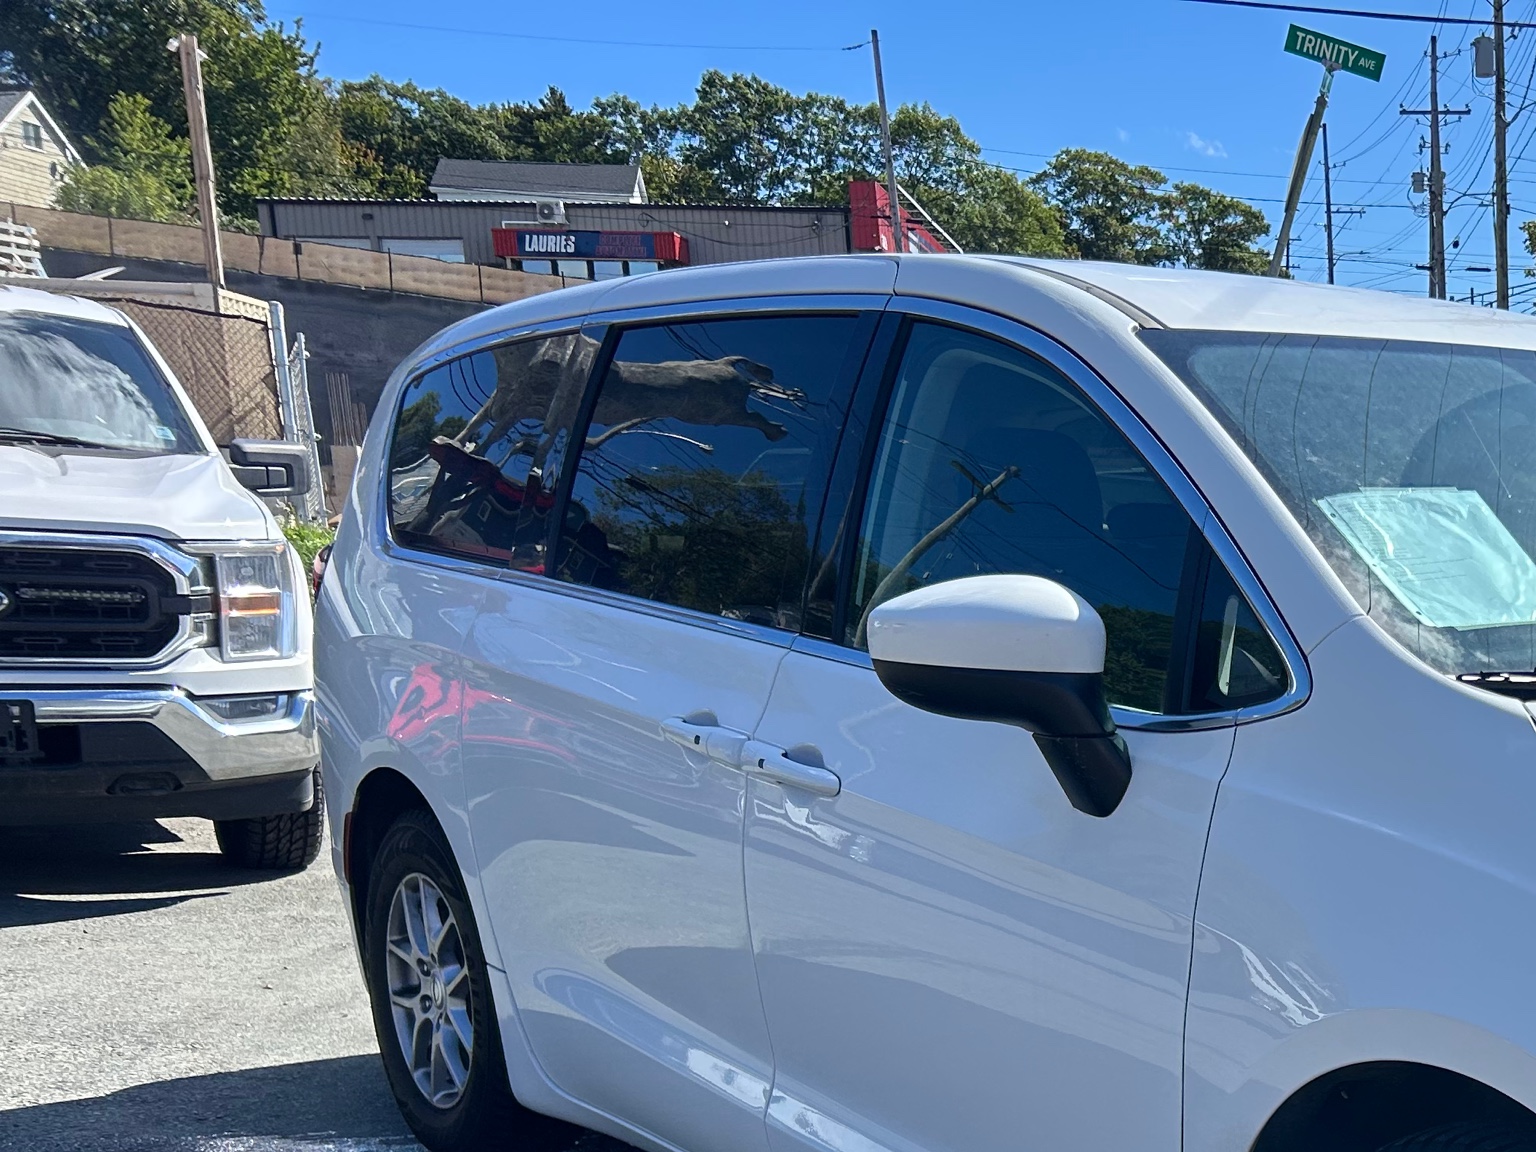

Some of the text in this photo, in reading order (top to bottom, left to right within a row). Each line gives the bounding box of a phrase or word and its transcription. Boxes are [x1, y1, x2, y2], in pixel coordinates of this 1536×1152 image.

[1296, 31, 1376, 71] TRINITY AVE
[524, 234, 576, 253] LAURIES
